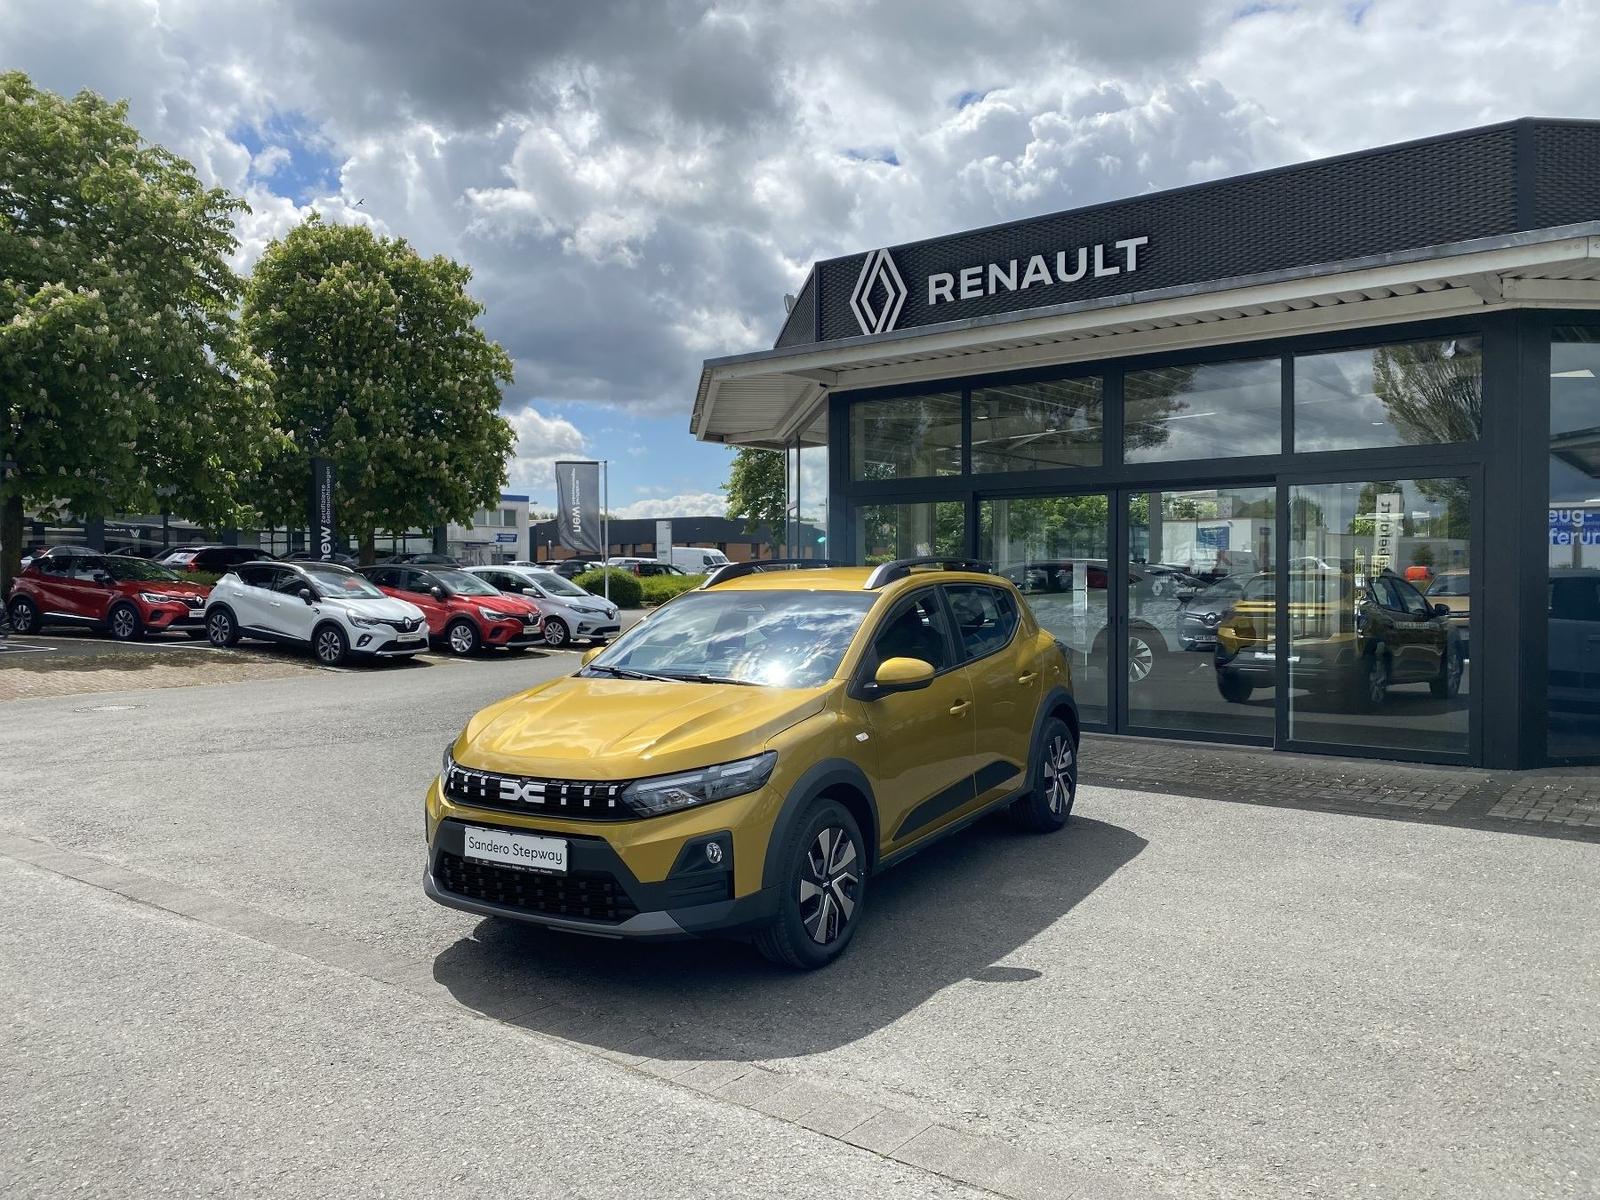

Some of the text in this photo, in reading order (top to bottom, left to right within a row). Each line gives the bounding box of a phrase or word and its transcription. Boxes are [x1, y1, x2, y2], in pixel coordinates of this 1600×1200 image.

[928, 236, 1148, 305] RENAULT
[468, 836, 563, 865] Sandero Stepway
